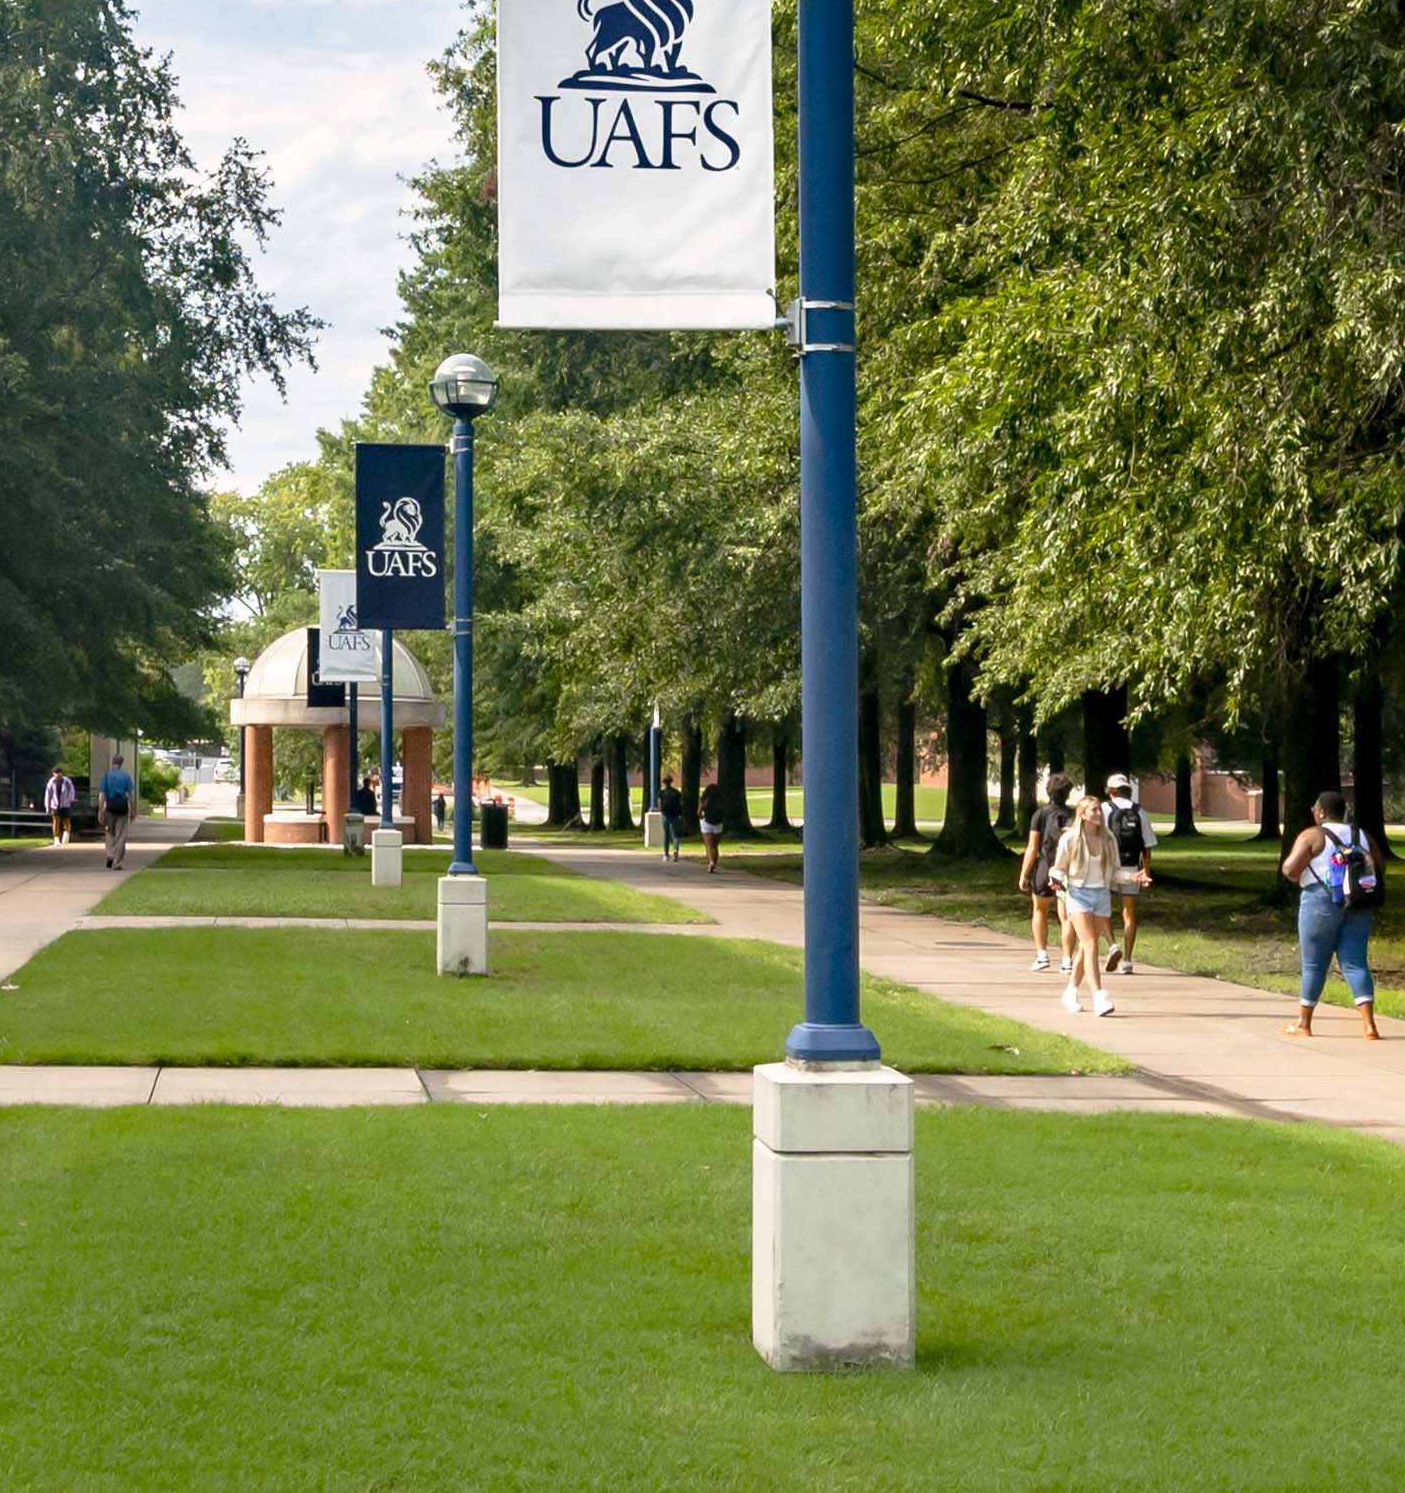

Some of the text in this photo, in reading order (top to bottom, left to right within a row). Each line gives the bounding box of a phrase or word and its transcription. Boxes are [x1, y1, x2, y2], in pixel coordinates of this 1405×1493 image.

[533, 95, 740, 171] UAFS
[366, 550, 437, 578] UAFS
[328, 634, 371, 651] UAFS
